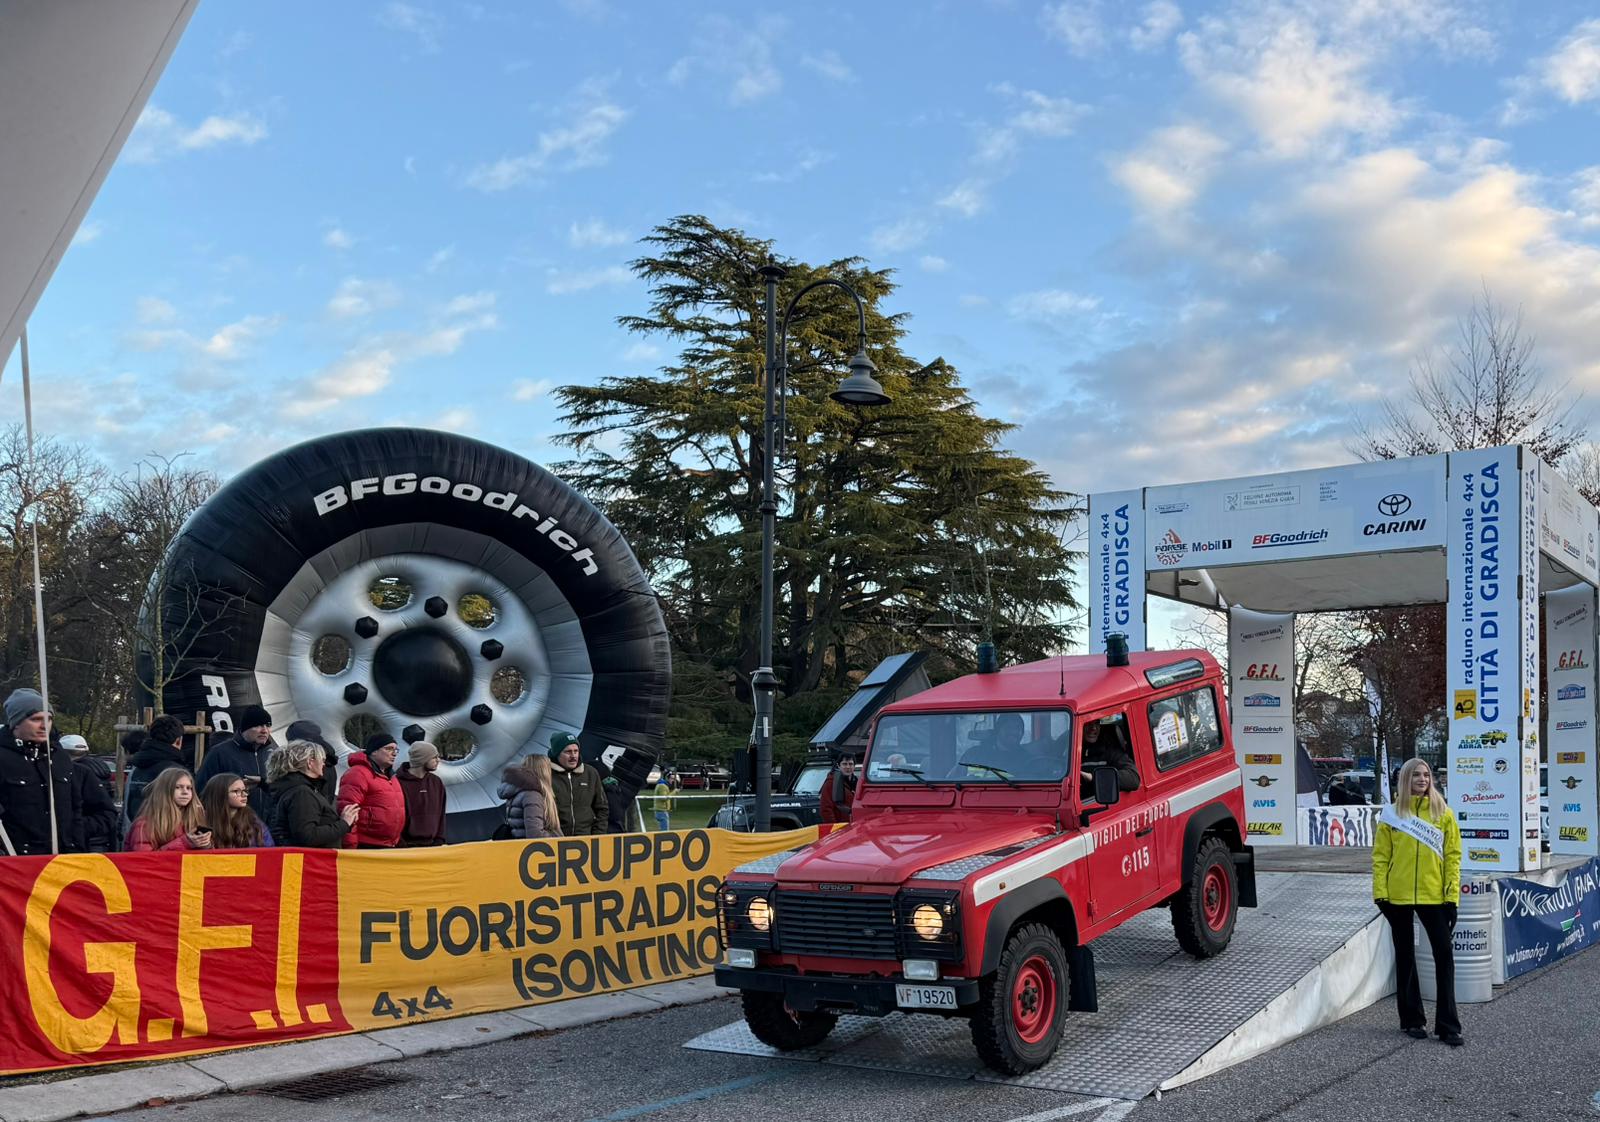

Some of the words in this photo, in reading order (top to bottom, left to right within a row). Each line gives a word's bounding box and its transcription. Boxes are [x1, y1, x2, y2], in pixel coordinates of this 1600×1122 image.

[1463, 472, 1474, 502] 4x4
[313, 472, 599, 577] BFGoodrich
[1101, 513, 1110, 538] 4x4
[1252, 529, 1328, 544] BFGoodrich
[1363, 519, 1427, 536] CARINI
[1480, 461, 1499, 601] GRADISCA
[1192, 540, 1221, 552] Mobil
[1115, 504, 1129, 625] GRADISCA
[1461, 507, 1474, 622] internazionale
[1480, 611, 1499, 639] DI
[1247, 664, 1279, 679] G.F.I.
[1461, 627, 1473, 685] raduno
[1559, 649, 1584, 668] G.F.I.
[1475, 648, 1499, 723] CITTÀ
[1563, 803, 1581, 812] AVIS
[1094, 822, 1122, 849] VIGILI
[1126, 814, 1140, 834] DEL
[1144, 801, 1169, 825] FUOCO
[519, 830, 711, 889] GRUPPO
[1133, 846, 1150, 872] 115
[1461, 882, 1485, 894] obil
[360, 875, 724, 964] FUORISTRADIS
[23, 853, 332, 1054] G.F.I.
[513, 926, 725, 1000] ISONTINO
[372, 985, 453, 1020] 4x4
[898, 989, 911, 1003] VF
[917, 989, 954, 1005] 19520
